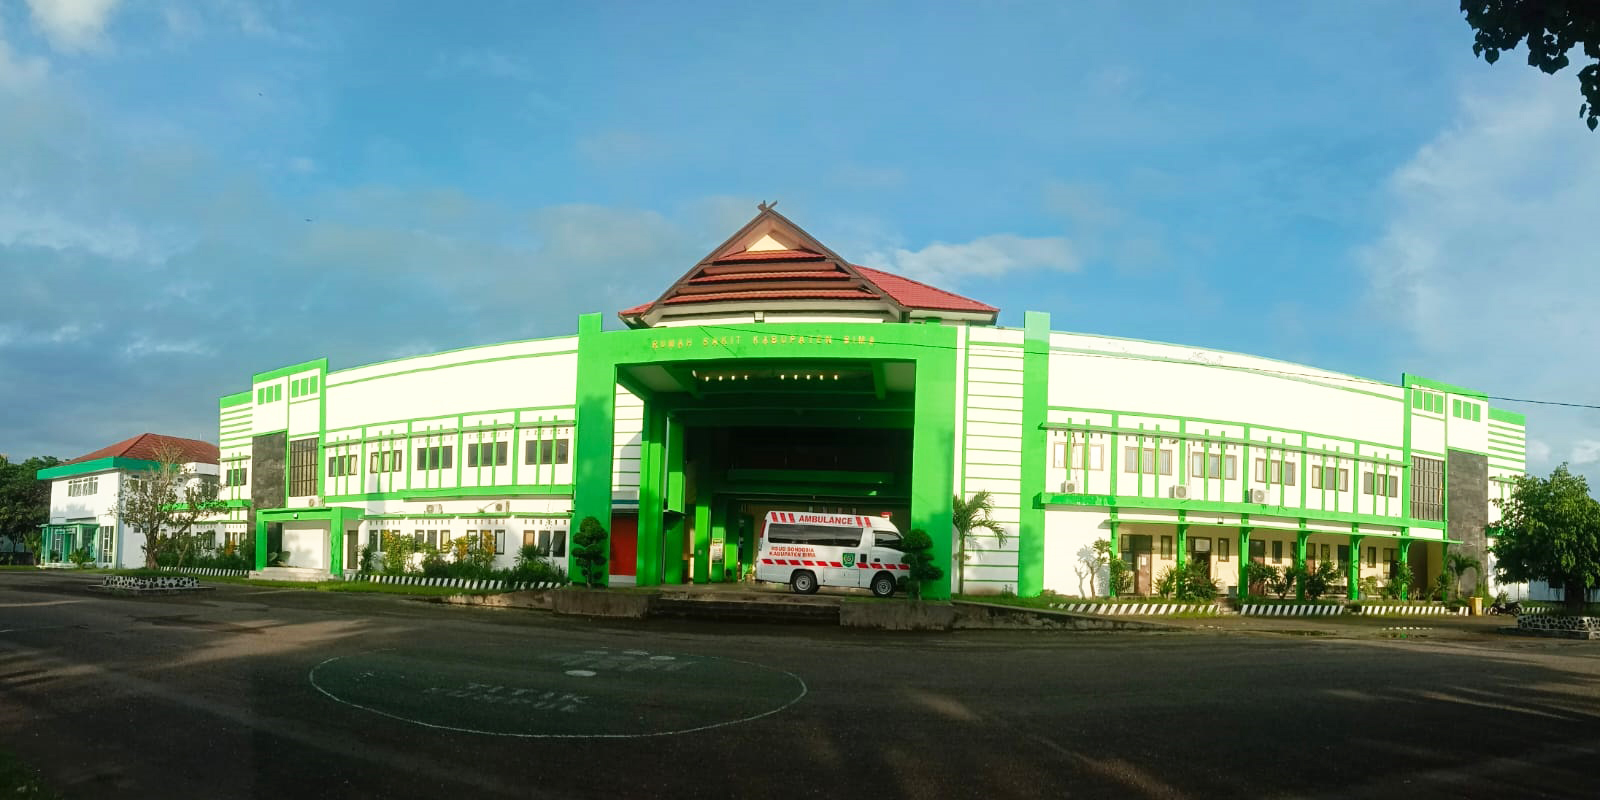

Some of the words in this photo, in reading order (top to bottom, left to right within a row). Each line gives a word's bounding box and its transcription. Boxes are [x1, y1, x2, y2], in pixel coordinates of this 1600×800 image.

[651, 337, 691, 349] RUMAH
[703, 335, 741, 346] SAKIT
[753, 335, 832, 345] KABUPATEN
[843, 335, 875, 345] BIMA
[799, 515, 853, 524] AMBULANCE
